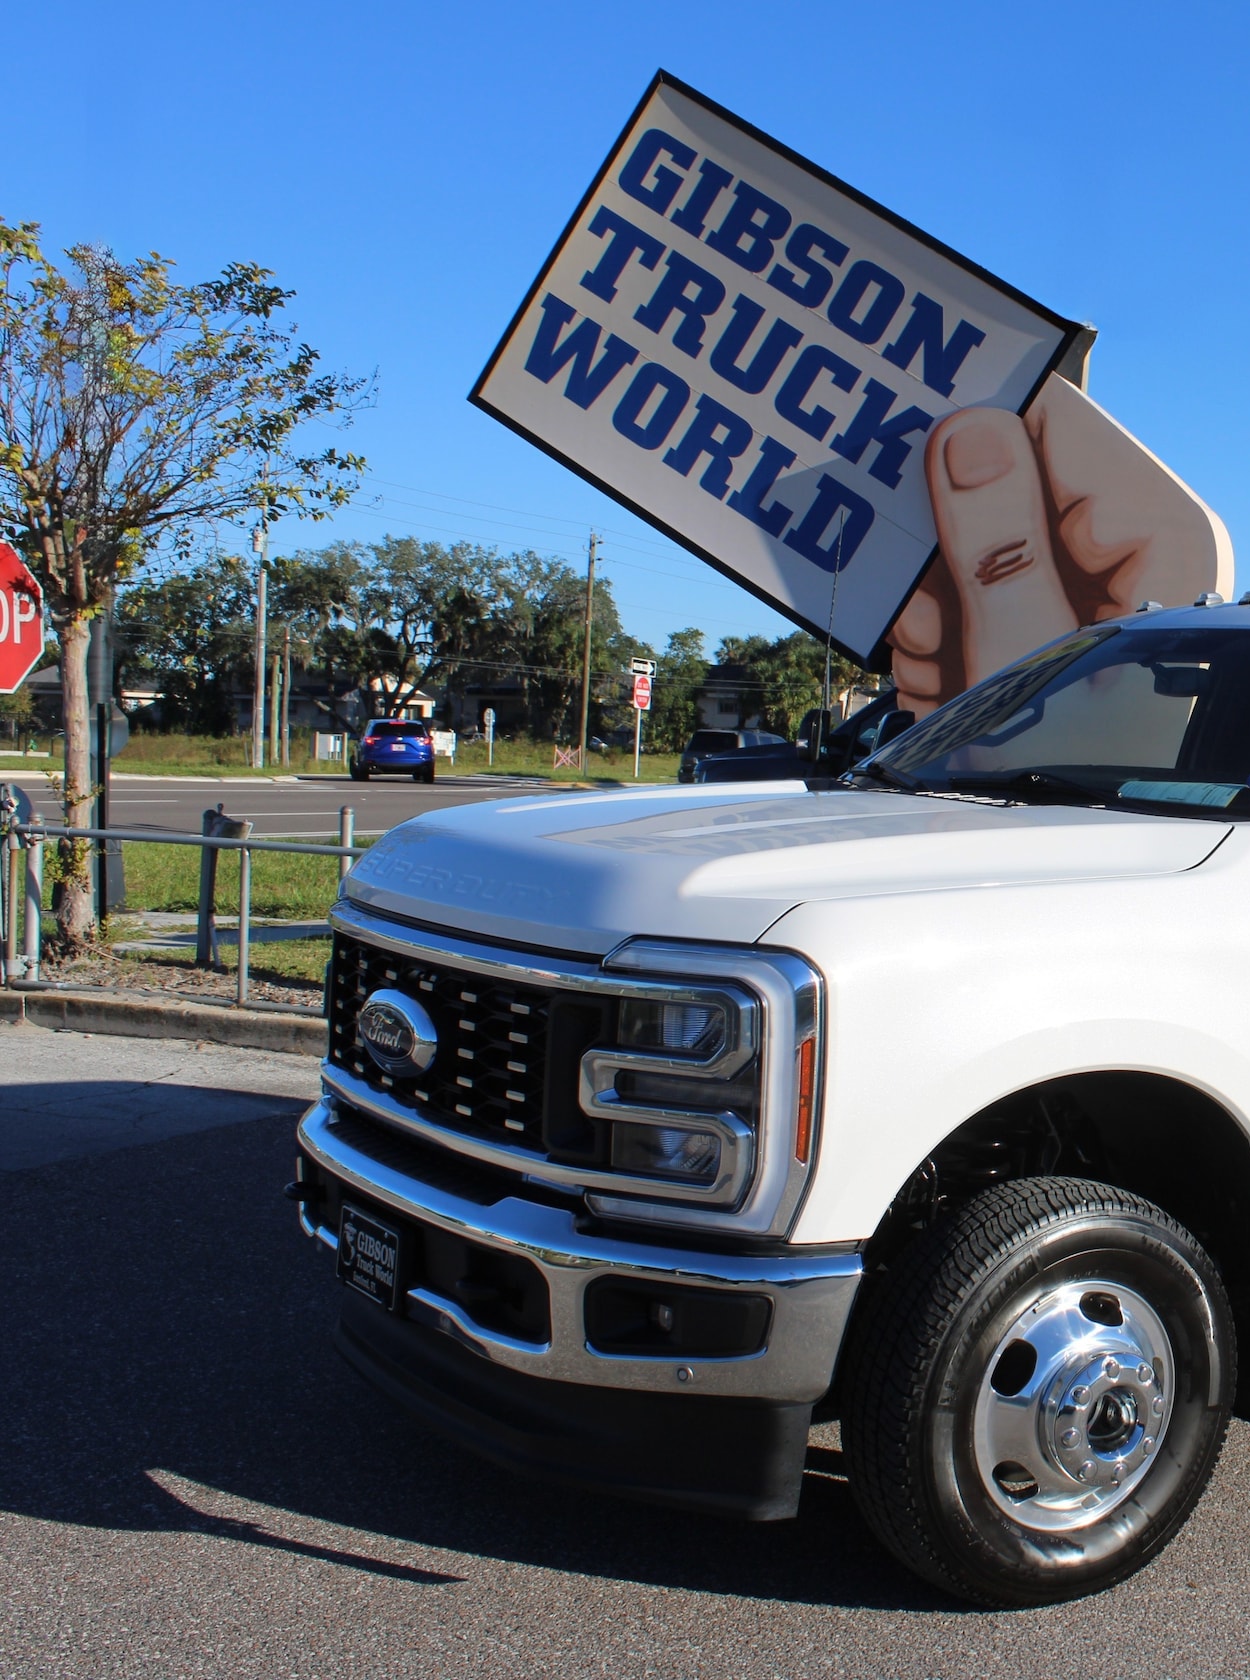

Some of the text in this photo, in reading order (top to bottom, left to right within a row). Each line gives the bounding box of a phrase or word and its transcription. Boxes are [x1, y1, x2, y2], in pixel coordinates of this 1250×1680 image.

[618, 128, 986, 399] GIBSON
[578, 204, 934, 490] TRUCK
[523, 292, 876, 574] WORLD
[360, 852, 453, 891] SUPER
[366, 1010, 402, 1048] Ford
[357, 1231, 396, 1270] GIBSON
[356, 1254, 393, 1287] Truck World
